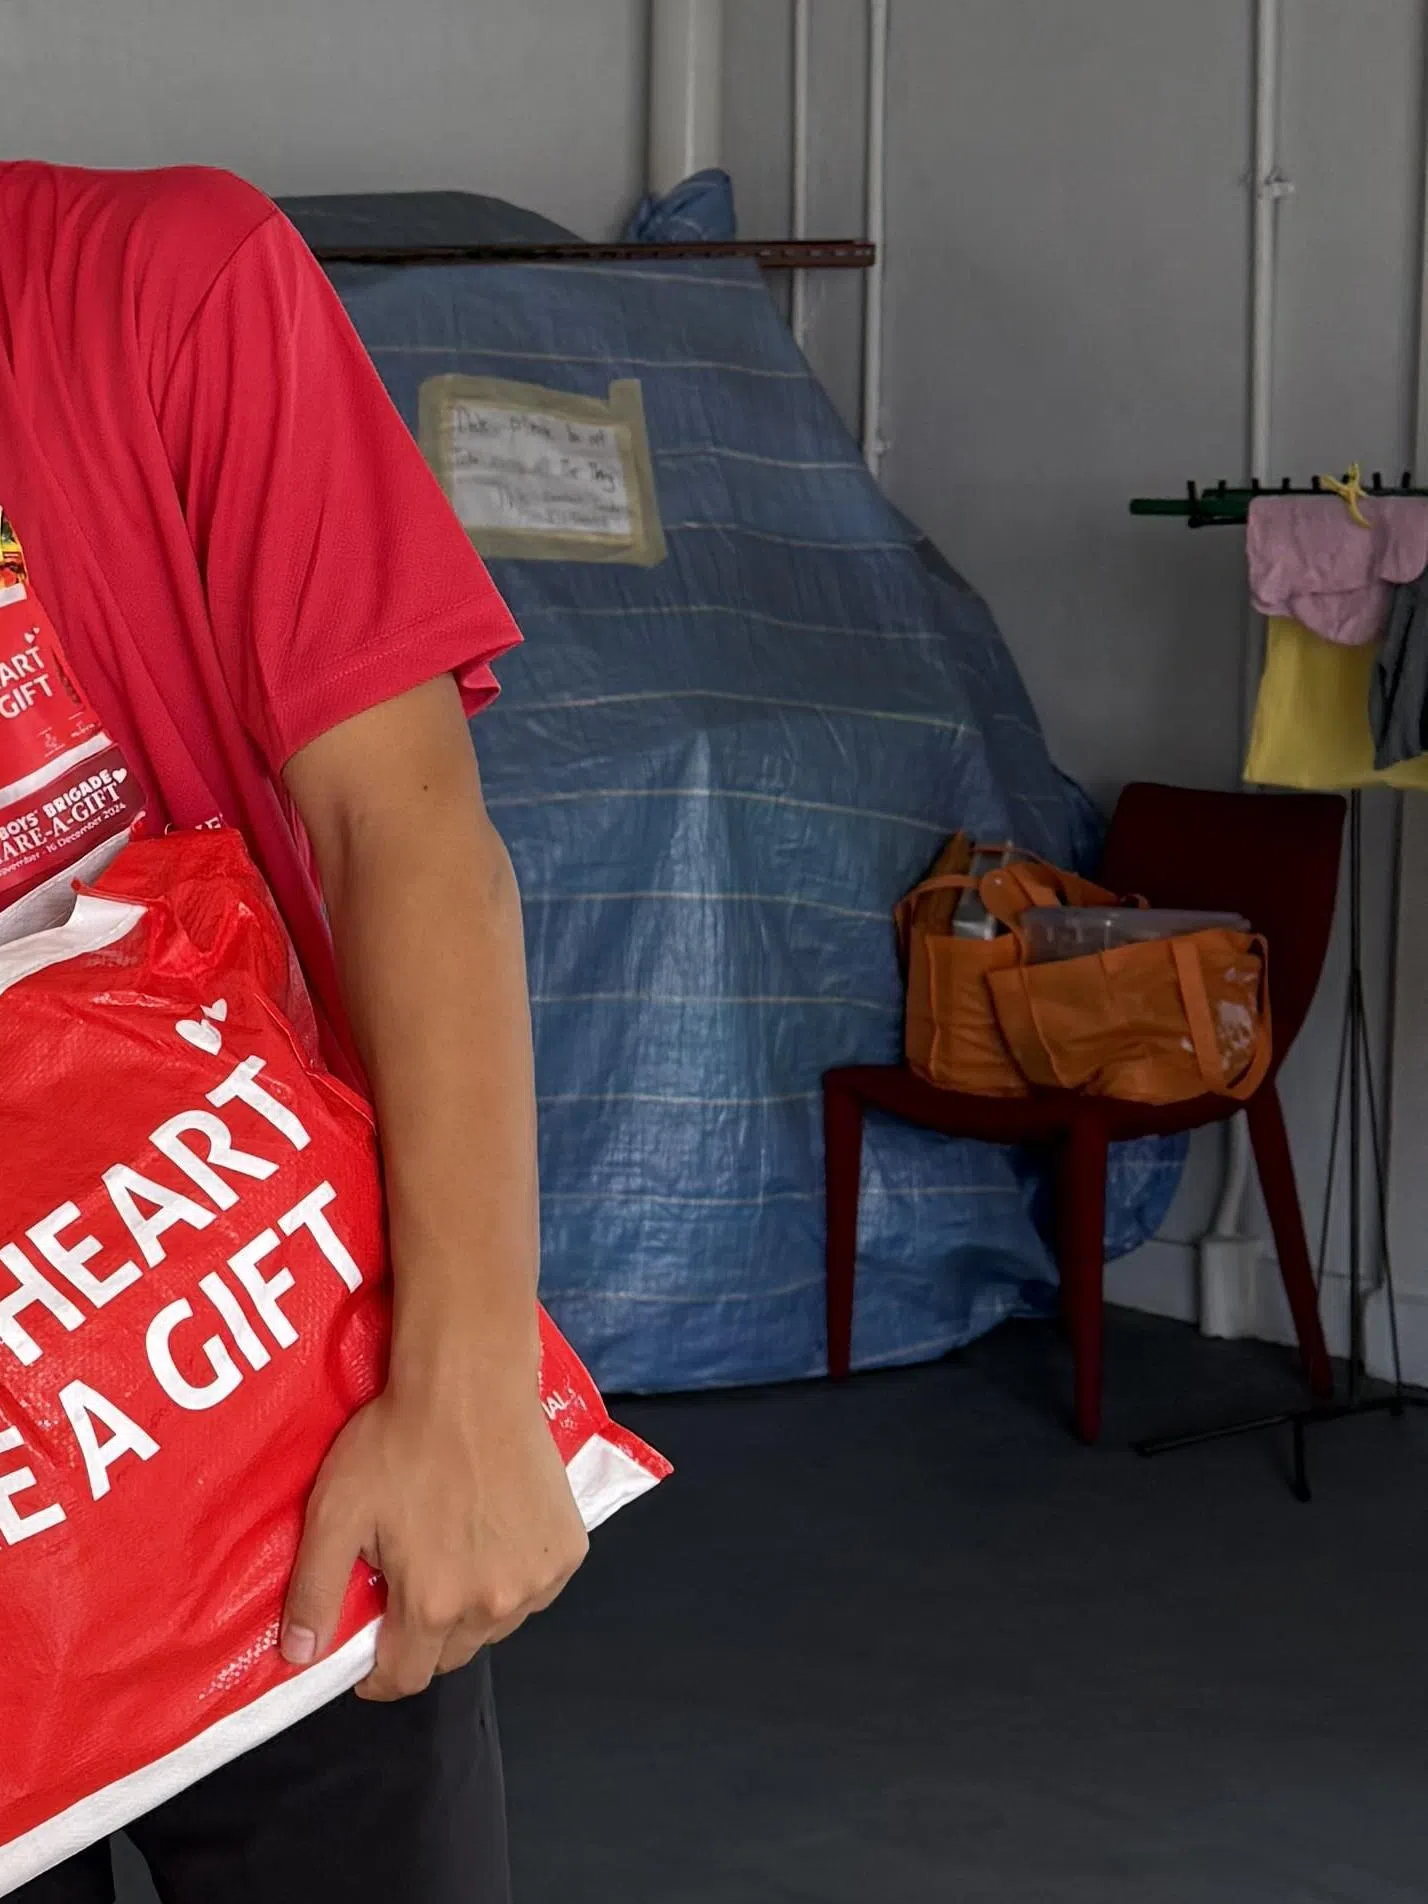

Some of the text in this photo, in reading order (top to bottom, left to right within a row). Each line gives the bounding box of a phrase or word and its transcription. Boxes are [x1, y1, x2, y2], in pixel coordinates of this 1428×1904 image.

[42, 769, 112, 818] BRIGADE
[70, 1379, 160, 1501] A
[144, 1180, 366, 1414] GIFT
